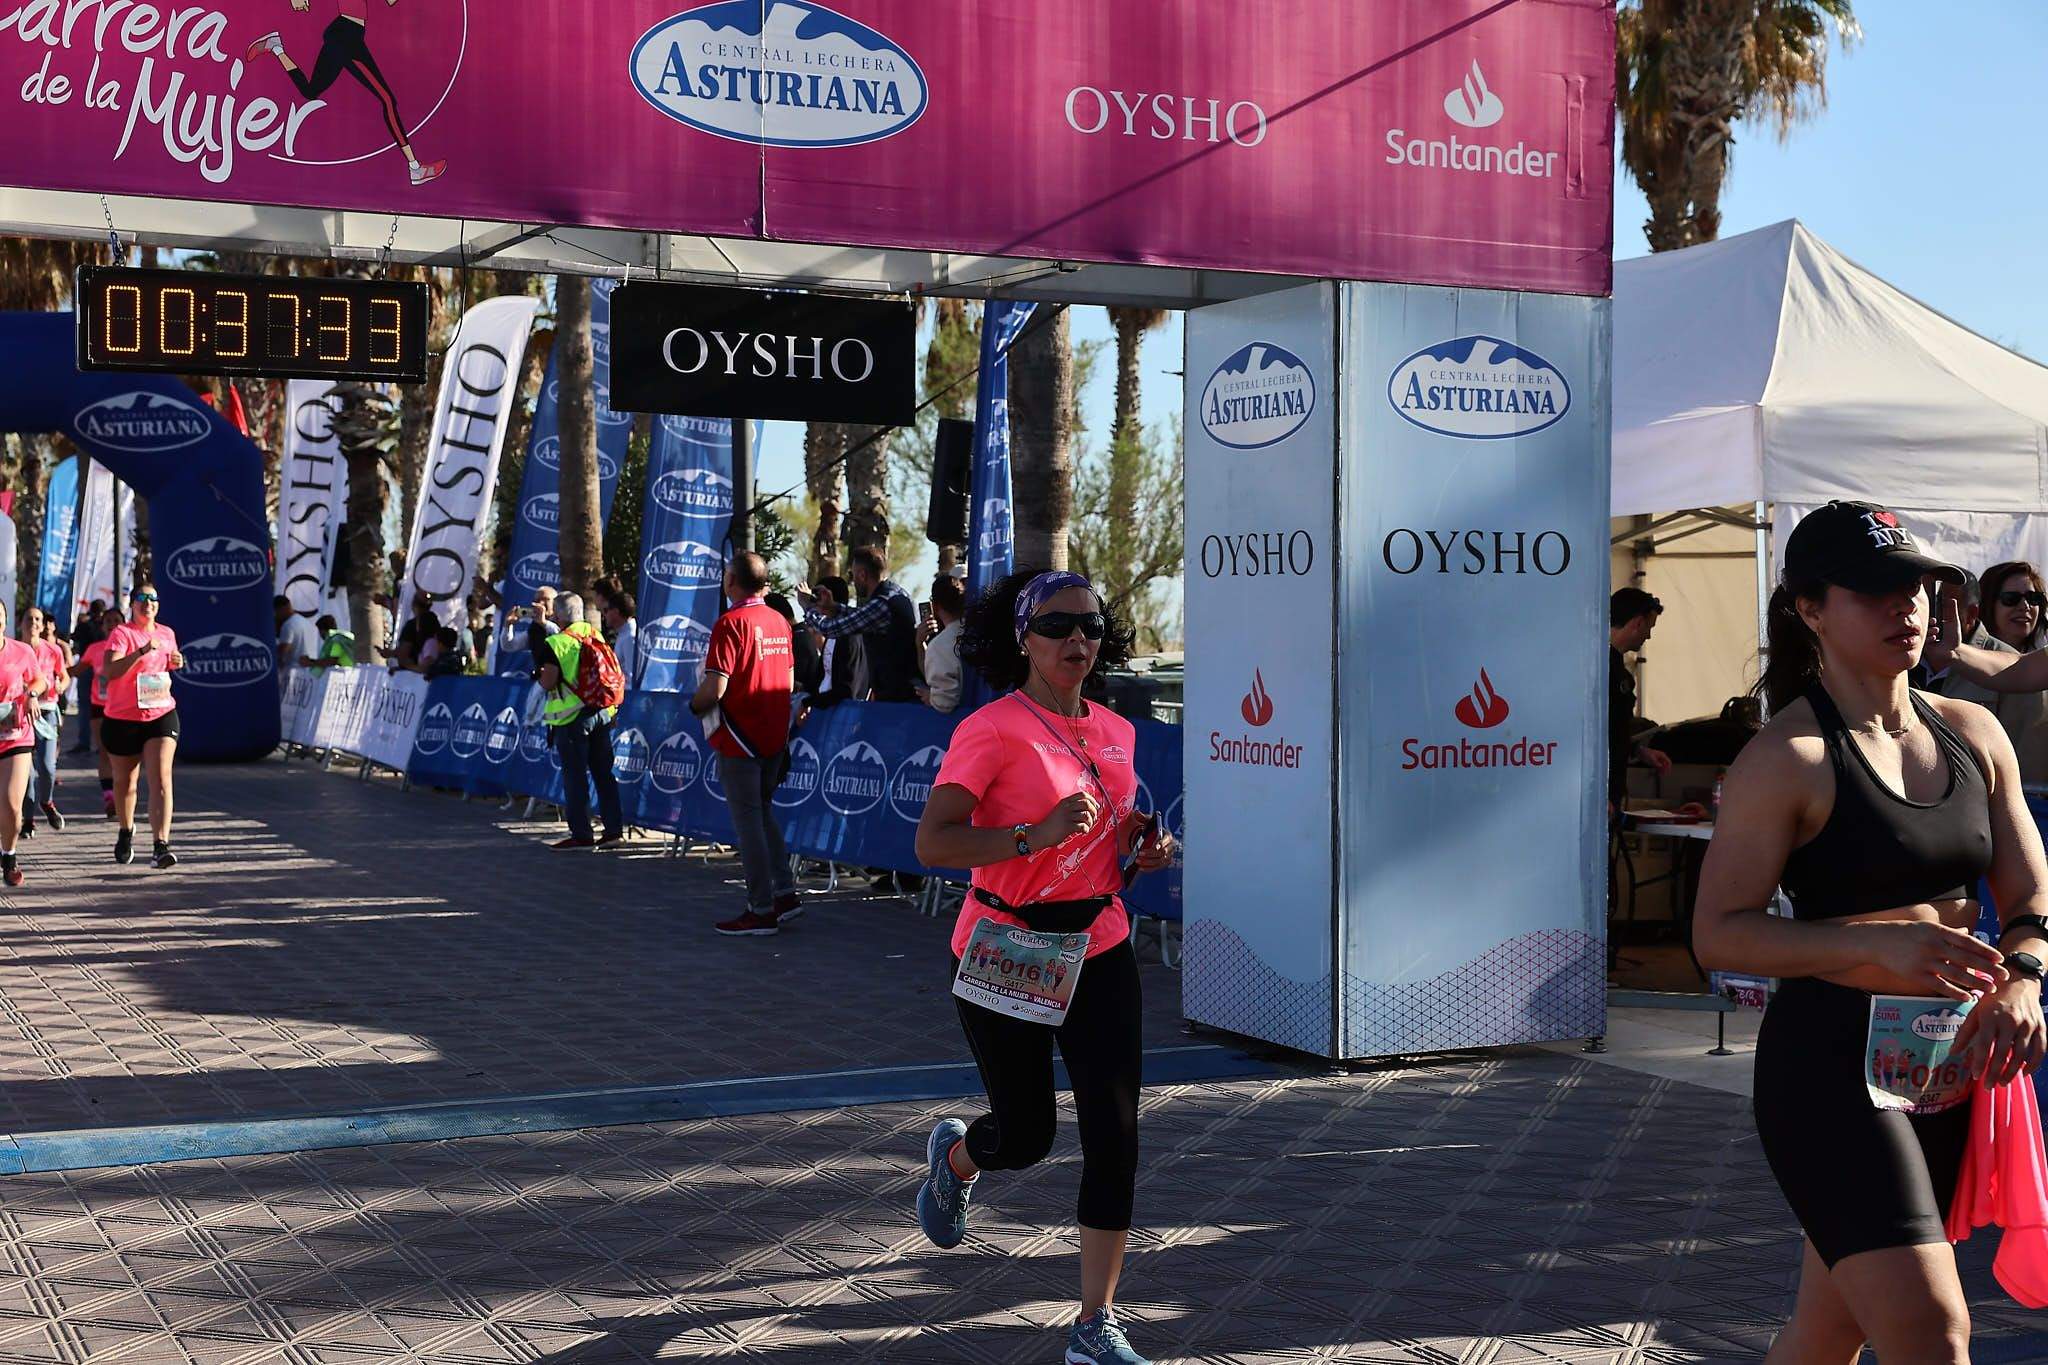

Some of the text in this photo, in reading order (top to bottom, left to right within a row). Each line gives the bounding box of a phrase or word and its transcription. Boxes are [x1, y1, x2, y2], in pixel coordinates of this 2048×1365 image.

[0, 0, 228, 62] arrera
[701, 41, 897, 73] CENTRAL LECHERA
[653, 40, 905, 116] ASTURIANA
[21, 51, 327, 184] de la Mujer
[1065, 86, 1268, 148] OYSHO
[1386, 129, 1558, 178] Santander
[663, 328, 874, 383] OYSHO
[1223, 373, 1303, 394] CENTRAL LECHERA
[1402, 371, 1557, 416] ASTURIANA
[1430, 369, 1552, 386] CENTRAL LECHERA
[1208, 387, 1306, 427] ASTURIANA
[86, 415, 202, 438] ASTURIANA
[667, 415, 732, 437] ASTURIA
[413, 343, 508, 601] OYSHO
[1382, 529, 1572, 576] OYSHO
[1868, 527, 1912, 548] NY
[174, 559, 263, 579] ASTURIANA
[1201, 530, 1314, 579] OYSHO
[517, 560, 560, 583] ASTURI
[1209, 731, 1304, 769] Santander
[1402, 736, 1558, 770] Santander
[825, 766, 881, 798] ASTURIANA
[893, 773, 930, 803] ASTUR
[1000, 958, 1041, 981] 016
[962, 975, 990, 990] CARRERA
[990, 983, 999, 993] DE
[999, 986, 1008, 996] LA
[1008, 989, 1030, 1001] MUJER
[1033, 996, 1062, 1009] VALENCIA
[965, 987, 1000, 1006] OYSHO
[1915, 1019, 1961, 1034] ASTURIAN
[1910, 1063, 1960, 1088] 016
